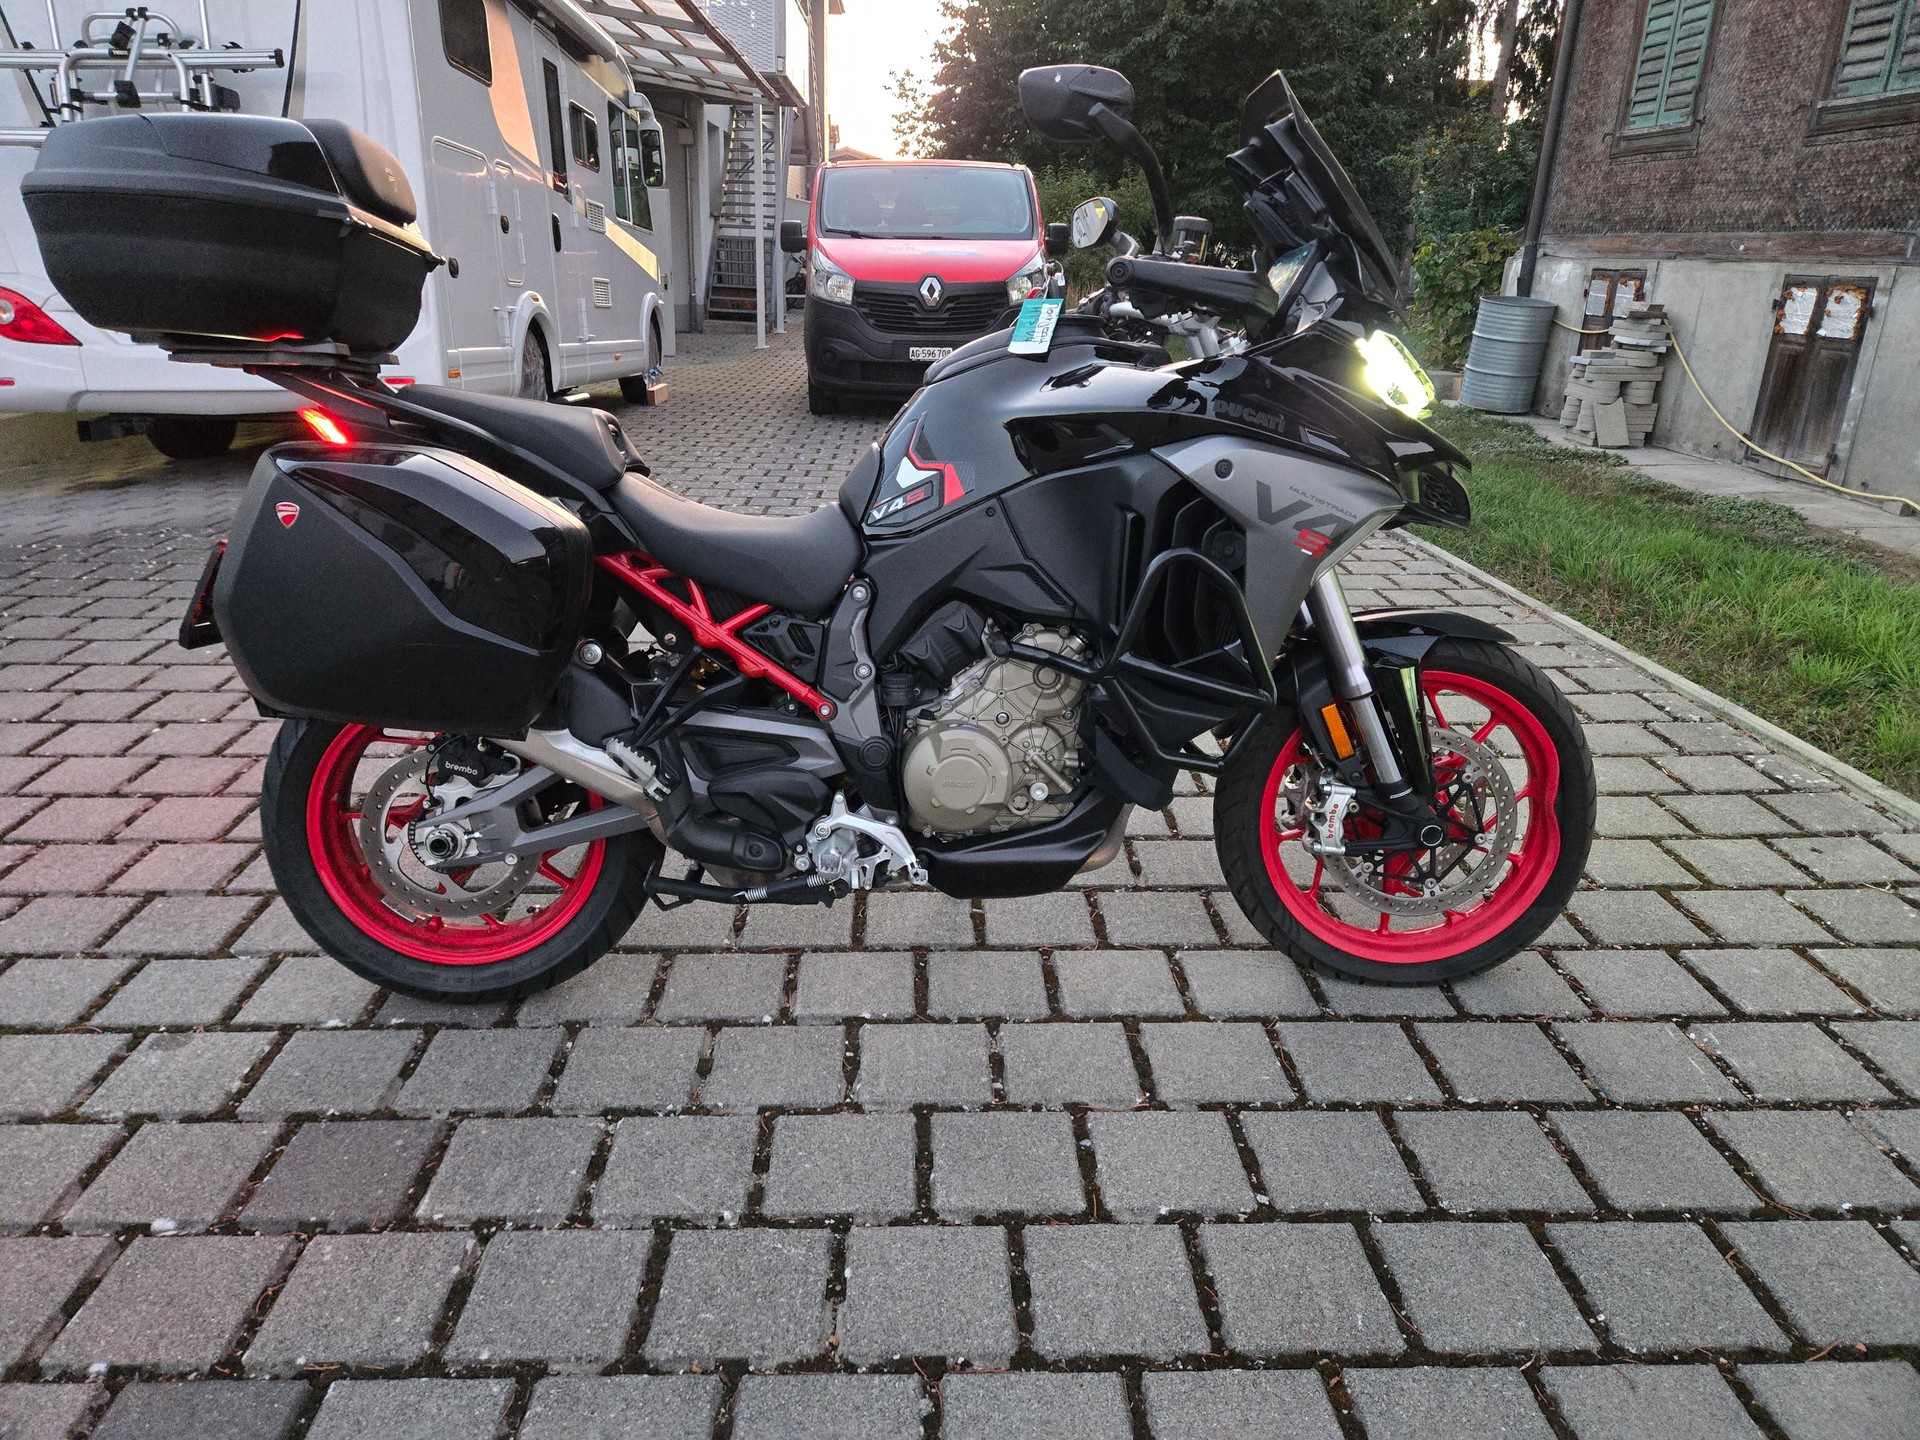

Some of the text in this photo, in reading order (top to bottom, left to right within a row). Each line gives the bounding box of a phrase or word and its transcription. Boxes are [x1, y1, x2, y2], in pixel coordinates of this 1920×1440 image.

[1288, 485, 1358, 519] MULTISTRADA
[445, 761, 478, 775] brembo
[1326, 803, 1339, 839] brembo
